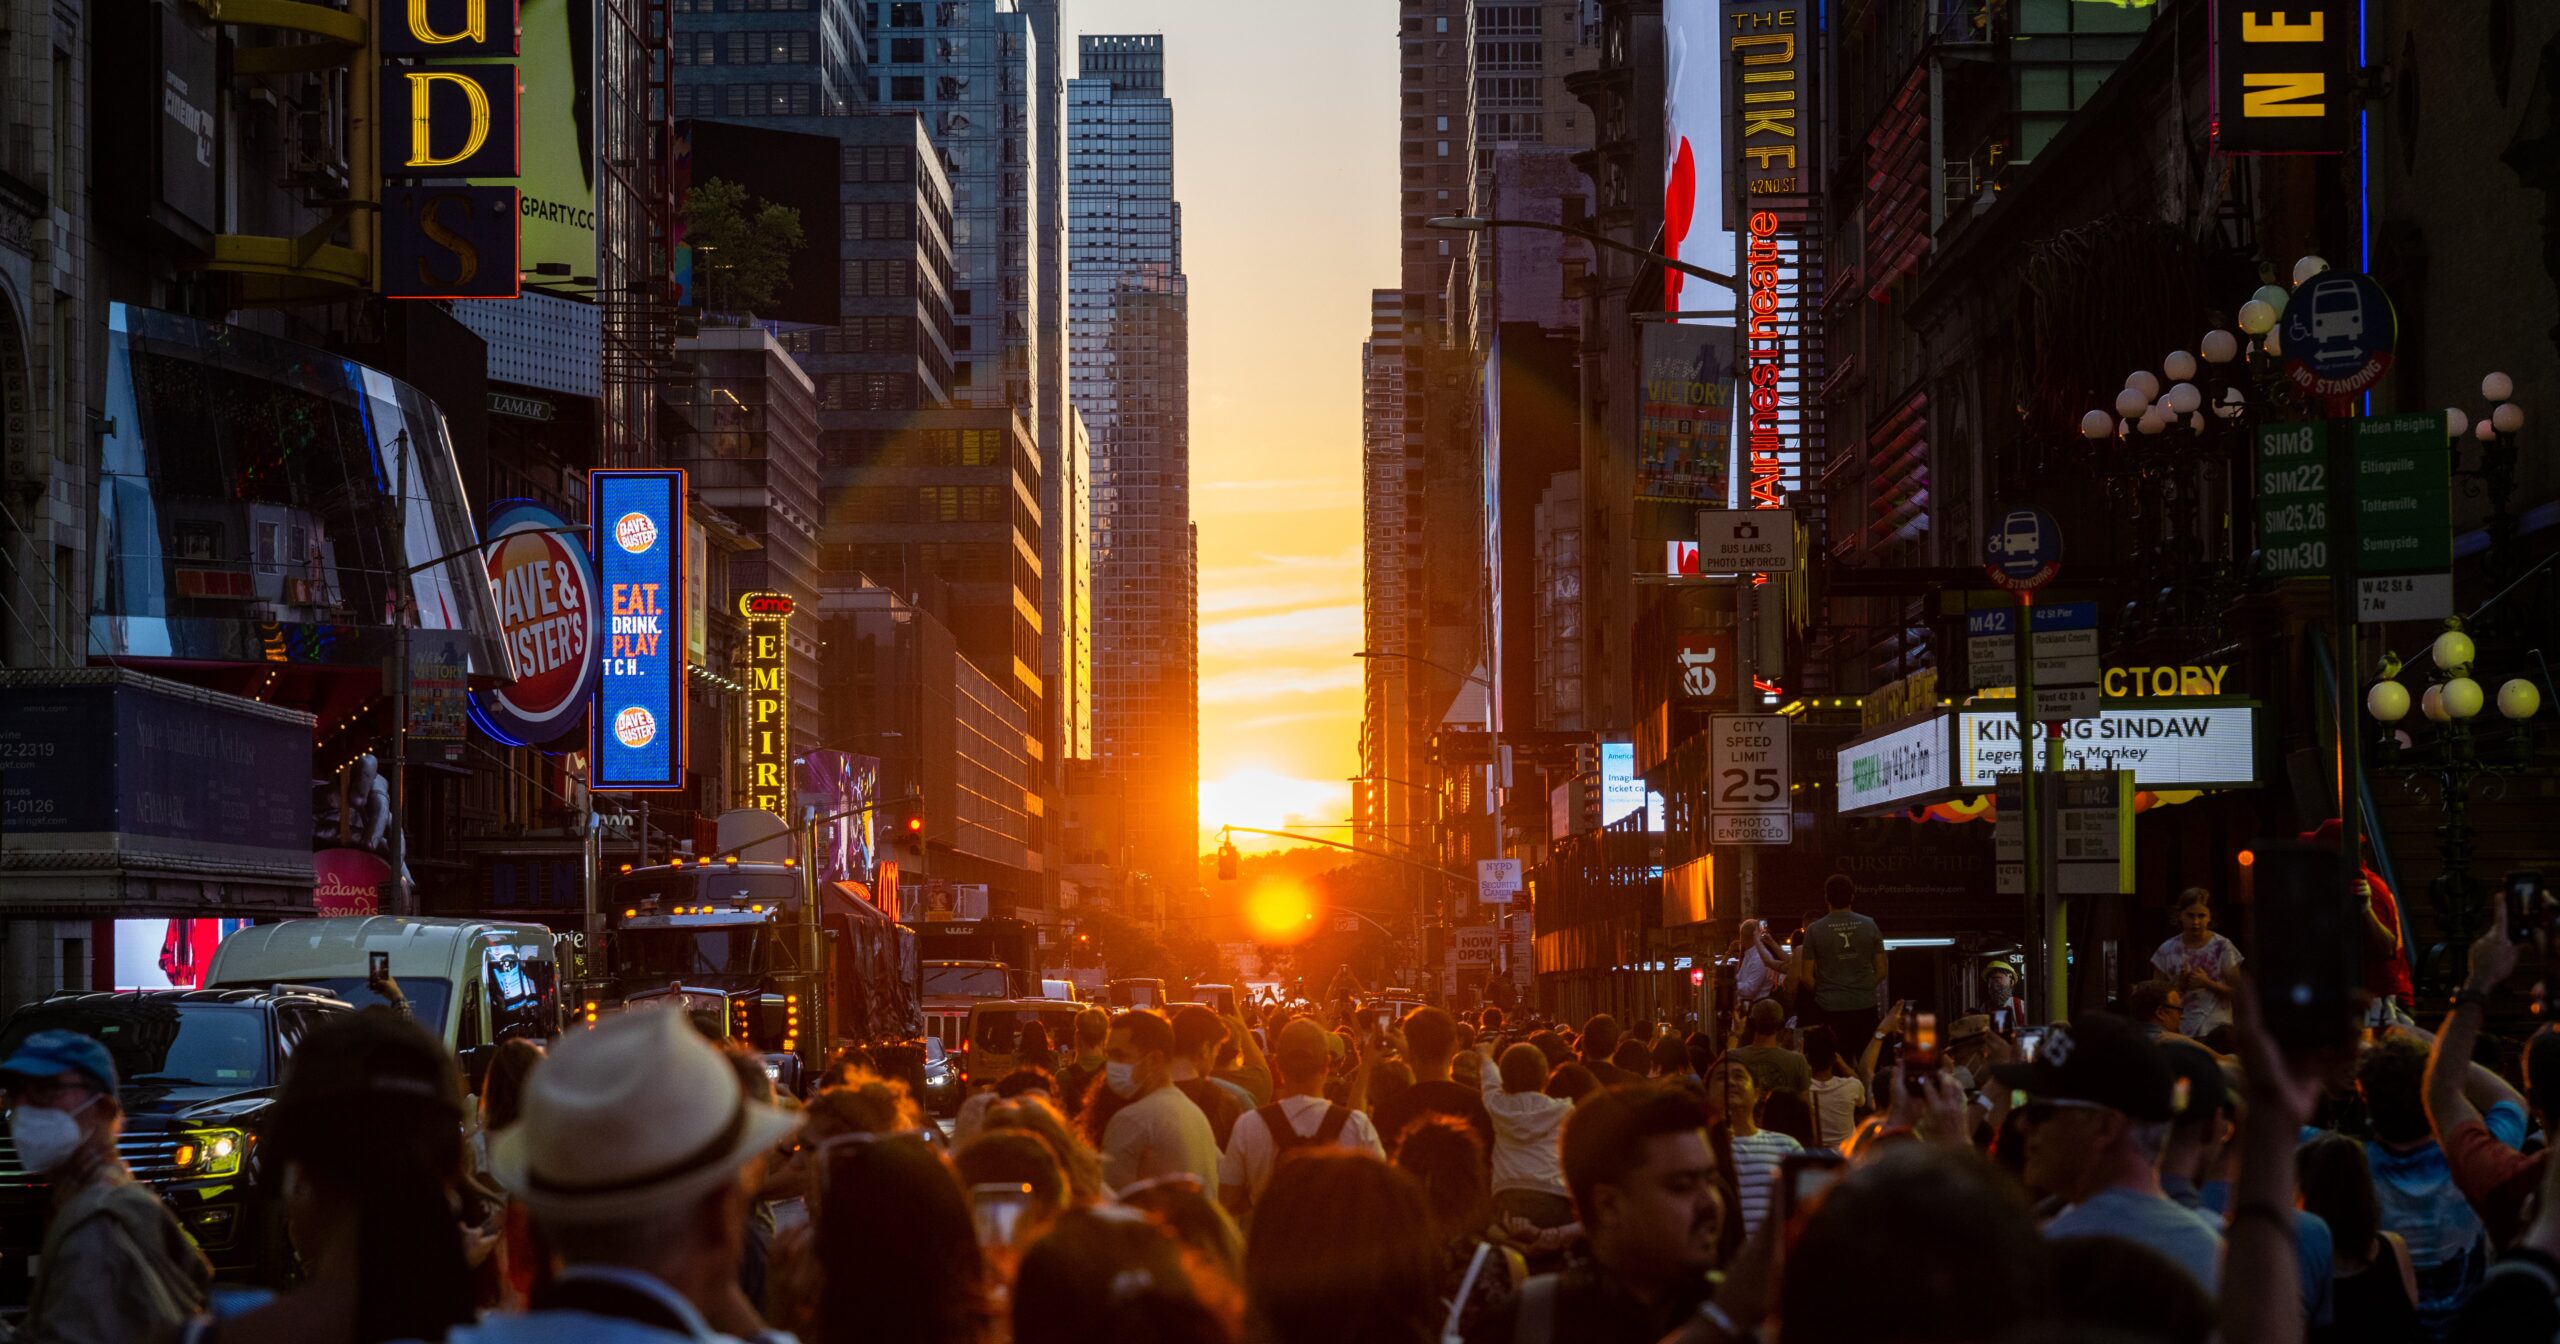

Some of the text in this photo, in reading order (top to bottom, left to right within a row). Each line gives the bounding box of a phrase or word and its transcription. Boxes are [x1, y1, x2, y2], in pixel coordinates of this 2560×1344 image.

[1730, 10, 1796, 29] THE
[1749, 176, 1797, 195] 42ND ST
[1649, 357, 1704, 379] NEW
[2291, 359, 2382, 395] NO STANDING
[1647, 378, 1729, 406] VICTORY
[493, 396, 543, 418] LAMAR
[2359, 417, 2436, 435] Arden Heights
[2263, 426, 2314, 457] SIM8
[2360, 458, 2415, 475] Eltingville
[2264, 464, 2325, 495] SIM22
[2361, 497, 2418, 513] Tottenville
[619, 516, 647, 536] DAVE
[2265, 502, 2326, 534] SIM25,26
[1720, 543, 1772, 554] BUS LANES
[2362, 535, 2419, 552] Sunnyside
[1707, 557, 1786, 568] PHOTO ENFORCED
[2266, 541, 2327, 572] SIM30
[554, 560, 580, 611] &
[1991, 565, 2054, 590] NO STANDING
[2363, 579, 2413, 593] W 42 St &
[611, 583, 663, 616] EAT.
[2363, 598, 2385, 610] 7 Av
[611, 616, 663, 635] DRINK.
[1969, 611, 2007, 632] M42
[503, 611, 584, 680] USTER'S
[611, 633, 660, 659] PLAY
[413, 664, 465, 680] VICTORY
[2098, 665, 2230, 698] CTORY
[2037, 692, 2057, 702] West
[2058, 692, 2068, 701] 42
[2045, 703, 2072, 712] Avenue
[136, 709, 162, 760] Space
[752, 634, 782, 818] EMPIRE
[1732, 721, 1765, 733] CITY
[2100, 717, 2210, 740] SINDAW
[1726, 736, 1772, 748] SPEED
[1731, 751, 1767, 763] LIMIT
[1978, 748, 2023, 764] Legen
[2063, 746, 2082, 759] he
[2086, 745, 2149, 762] Monkey
[1608, 784, 1633, 793] ticket
[1721, 768, 1781, 803] 25
[2083, 785, 2110, 805] M42
[136, 790, 187, 829] NEWMARK
[1730, 817, 1771, 828] PHOTO
[1718, 828, 1784, 839] ENFORCED
[1486, 862, 1513, 871] NYPD
[1836, 855, 1983, 872] CURSED CHILD
[313, 871, 378, 897] adame
[1483, 889, 1514, 897] CAMER
[1854, 883, 1967, 896] HarryPotterBroadway.com
[313, 896, 378, 918] ssauds
[1461, 936, 1493, 948] NOW
